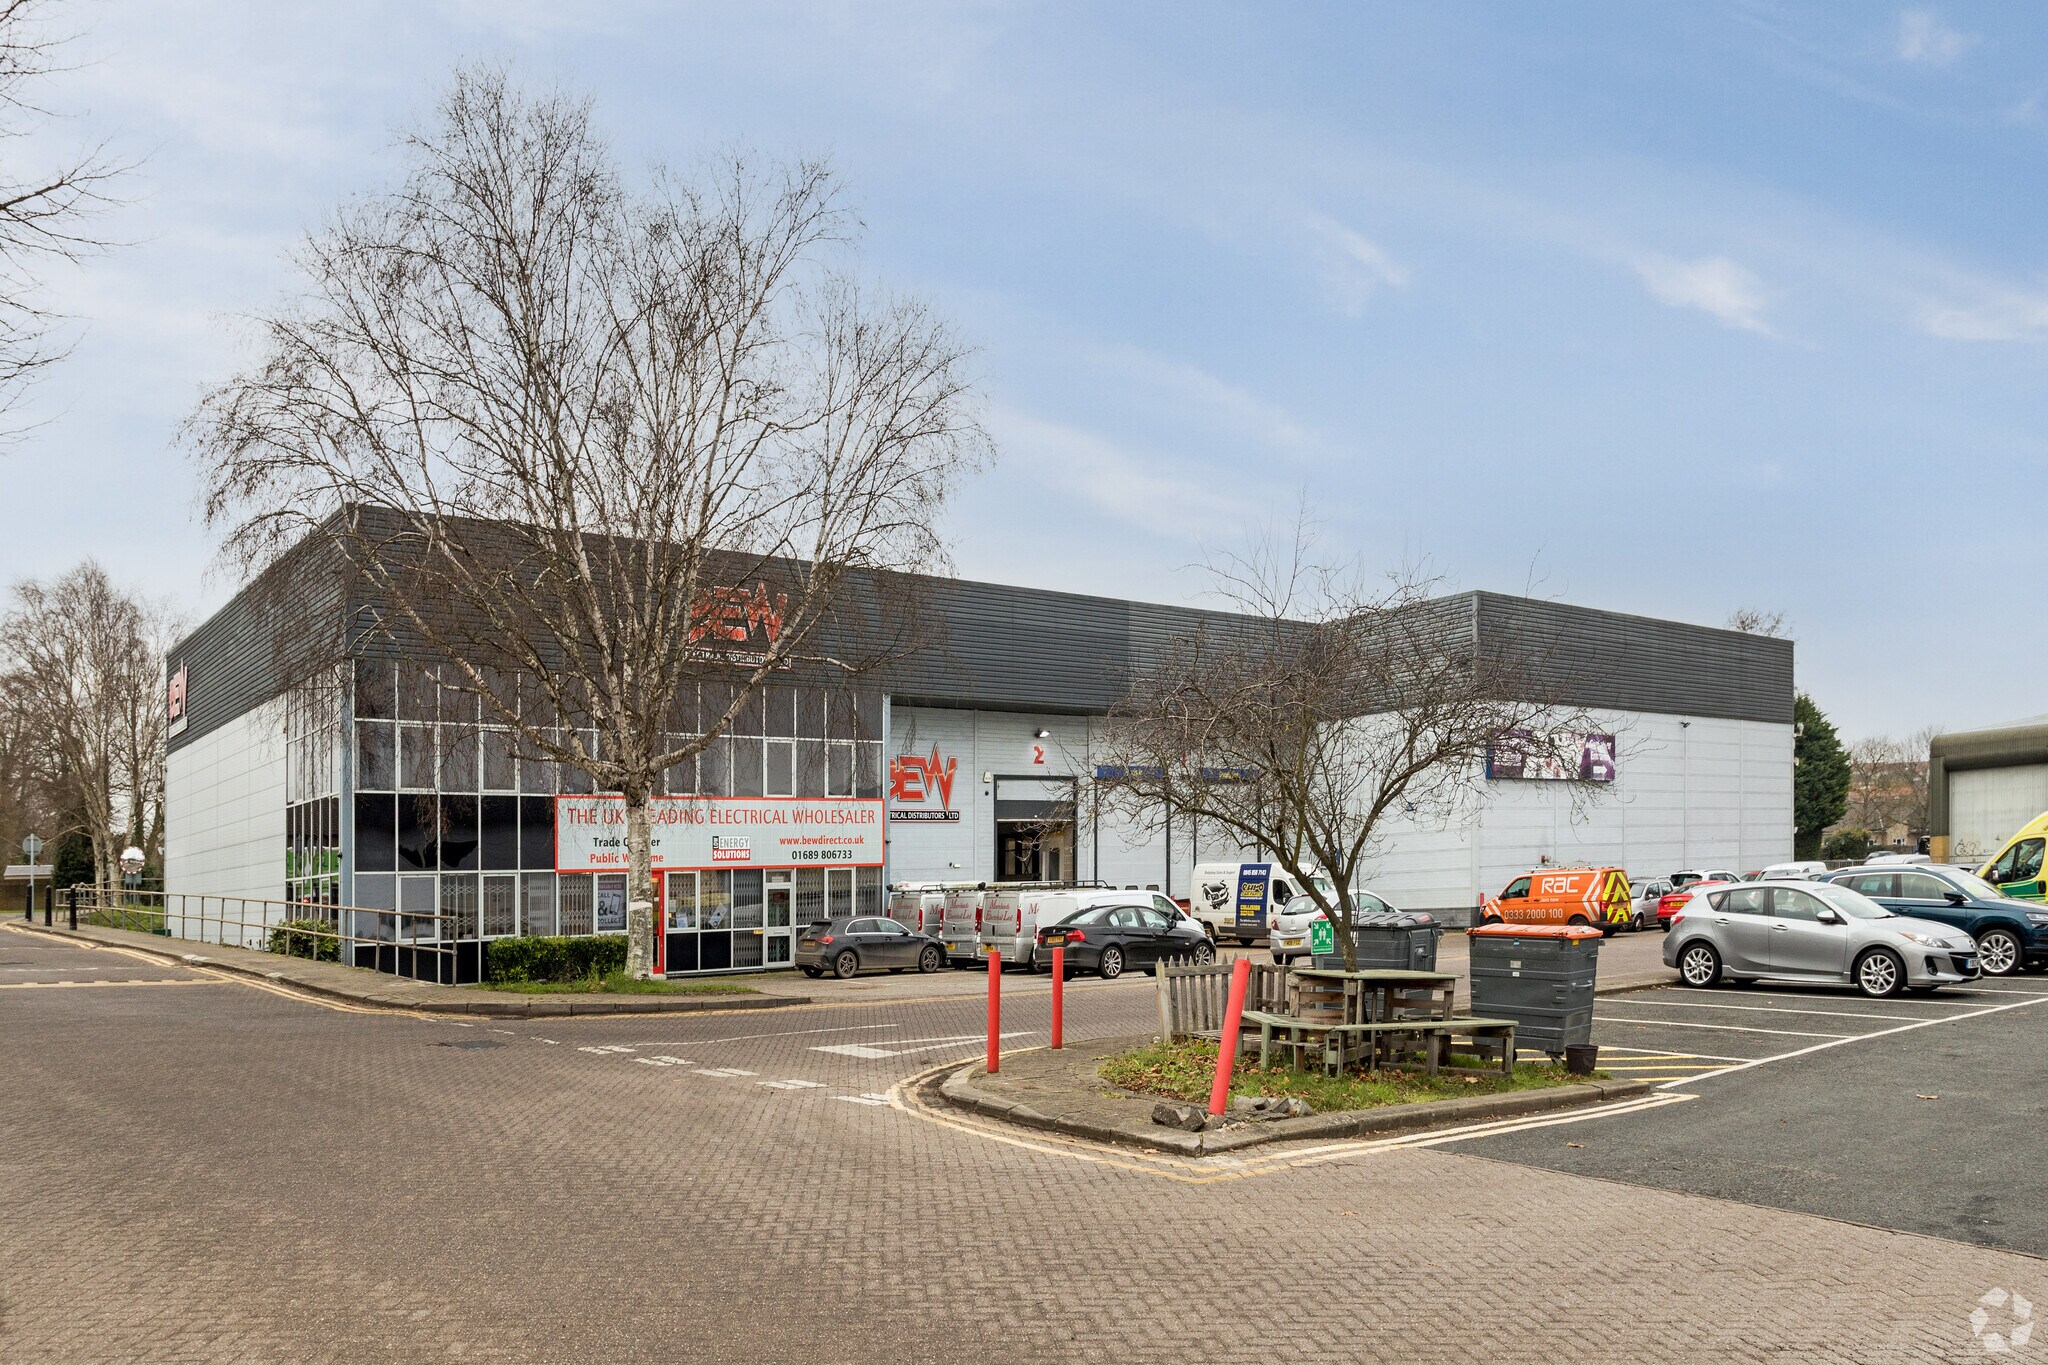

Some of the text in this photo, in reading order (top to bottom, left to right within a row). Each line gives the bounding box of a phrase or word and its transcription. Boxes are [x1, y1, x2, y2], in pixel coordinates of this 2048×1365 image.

[1033, 745, 1045, 765] 2
[567, 808, 597, 824] THE
[647, 808, 705, 825] EADING
[709, 809, 788, 825] ELECTRICAL
[792, 809, 876, 824] WHOLESALER
[907, 811, 945, 819] DISTRIBUTORS
[948, 811, 959, 819] LTD
[593, 837, 621, 848] Trade
[719, 837, 750, 849] ENERGY
[779, 835, 865, 845] www.bewdirect.co.uk
[590, 853, 619, 864] Public
[713, 849, 750, 860] SOLUTIONS
[791, 850, 853, 860] 01689 806733
[1504, 908, 1563, 920] 0333 2000 100
